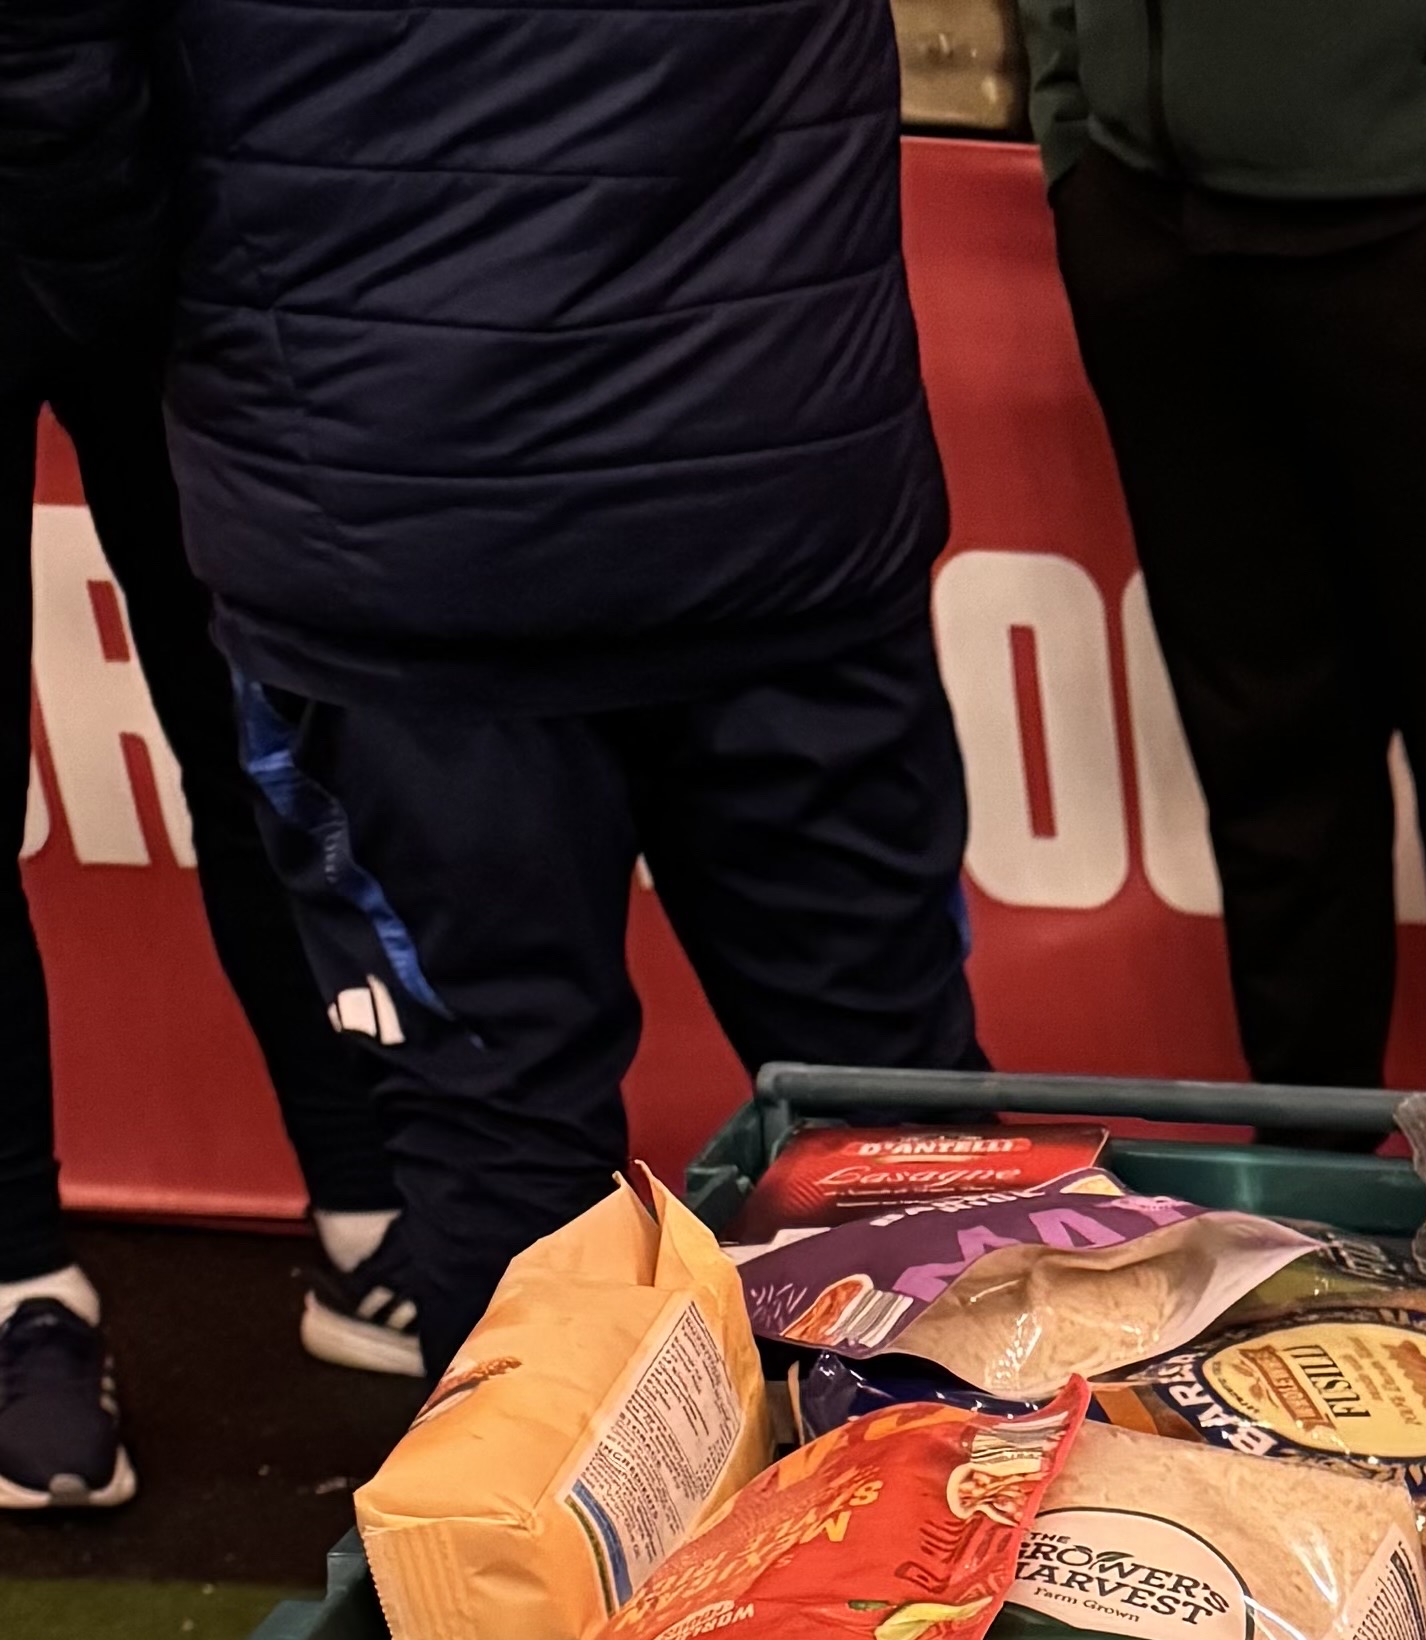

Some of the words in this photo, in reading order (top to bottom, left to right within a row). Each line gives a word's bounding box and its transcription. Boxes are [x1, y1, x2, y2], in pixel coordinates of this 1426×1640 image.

[858, 1138, 1014, 1157] D'ANTELLI
[814, 1165, 1022, 1188] Lasagne
[1029, 1531, 1071, 1545] THE
[1033, 1586, 1079, 1605] Farm
[1083, 1600, 1141, 1623] Grown
